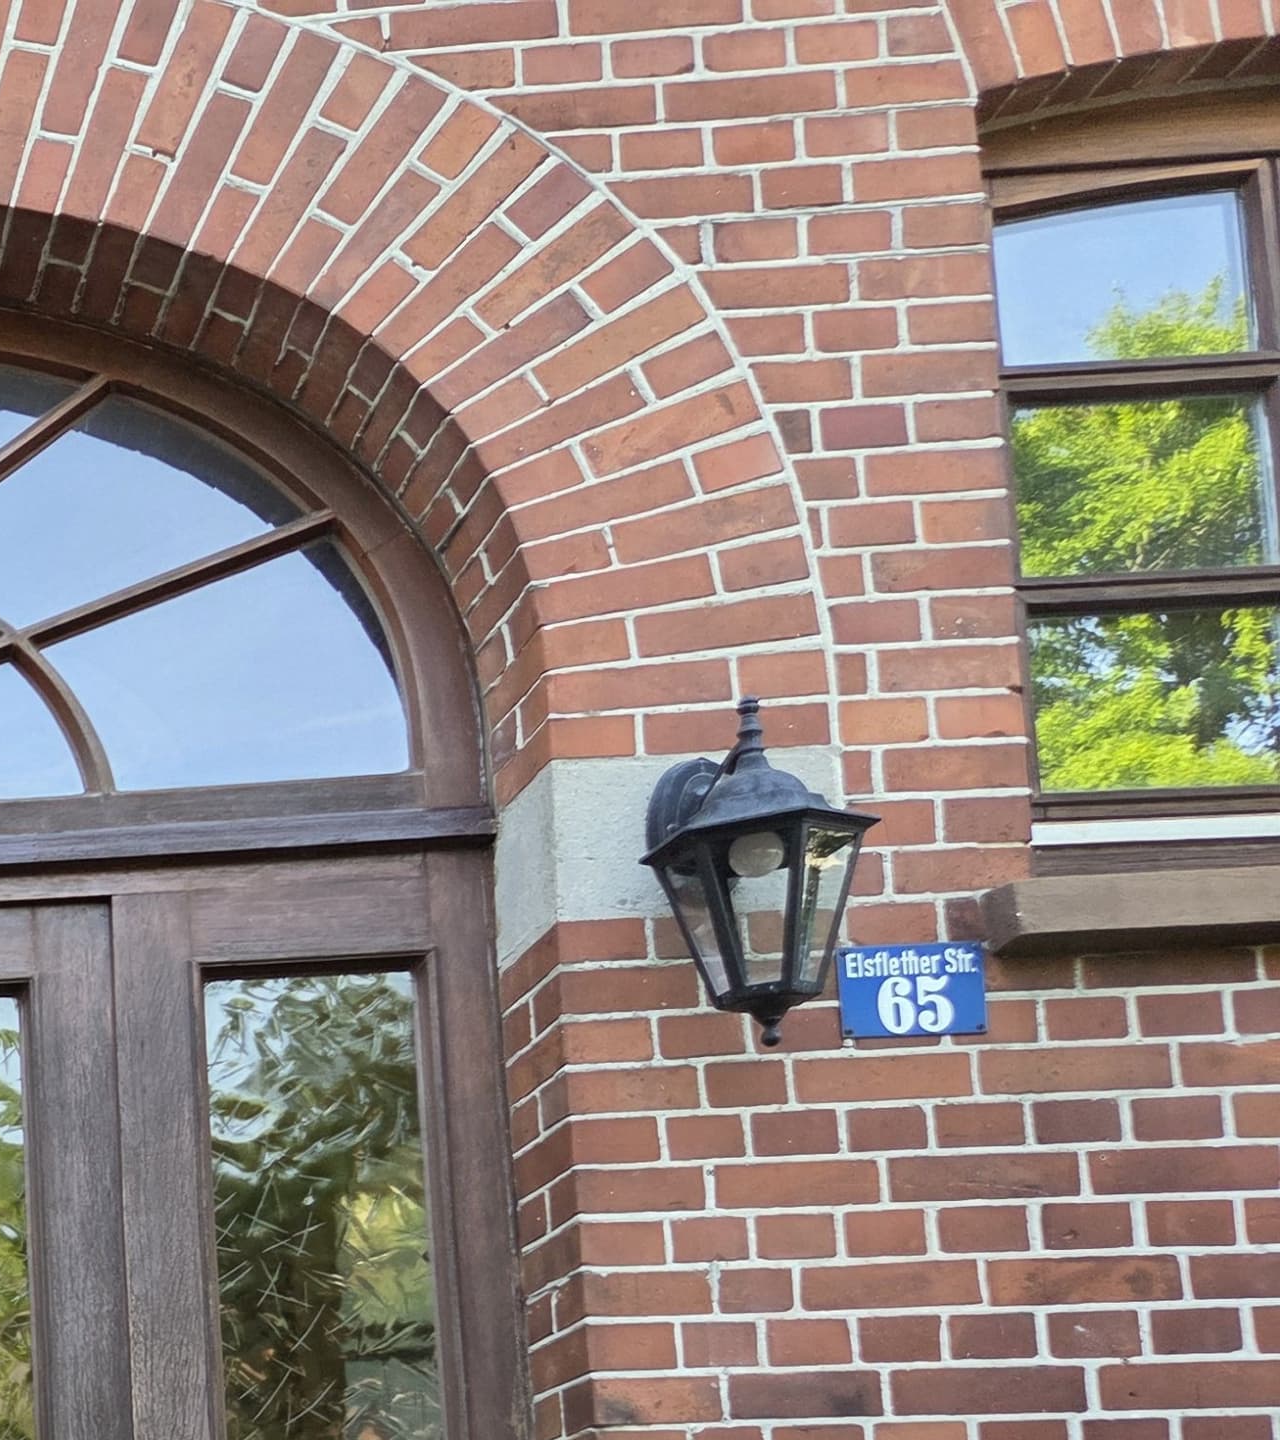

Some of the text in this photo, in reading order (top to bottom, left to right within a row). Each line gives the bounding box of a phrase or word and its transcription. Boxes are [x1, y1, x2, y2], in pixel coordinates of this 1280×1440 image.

[845, 948, 977, 978] Elsflether Str.
[877, 975, 954, 1034] 65
